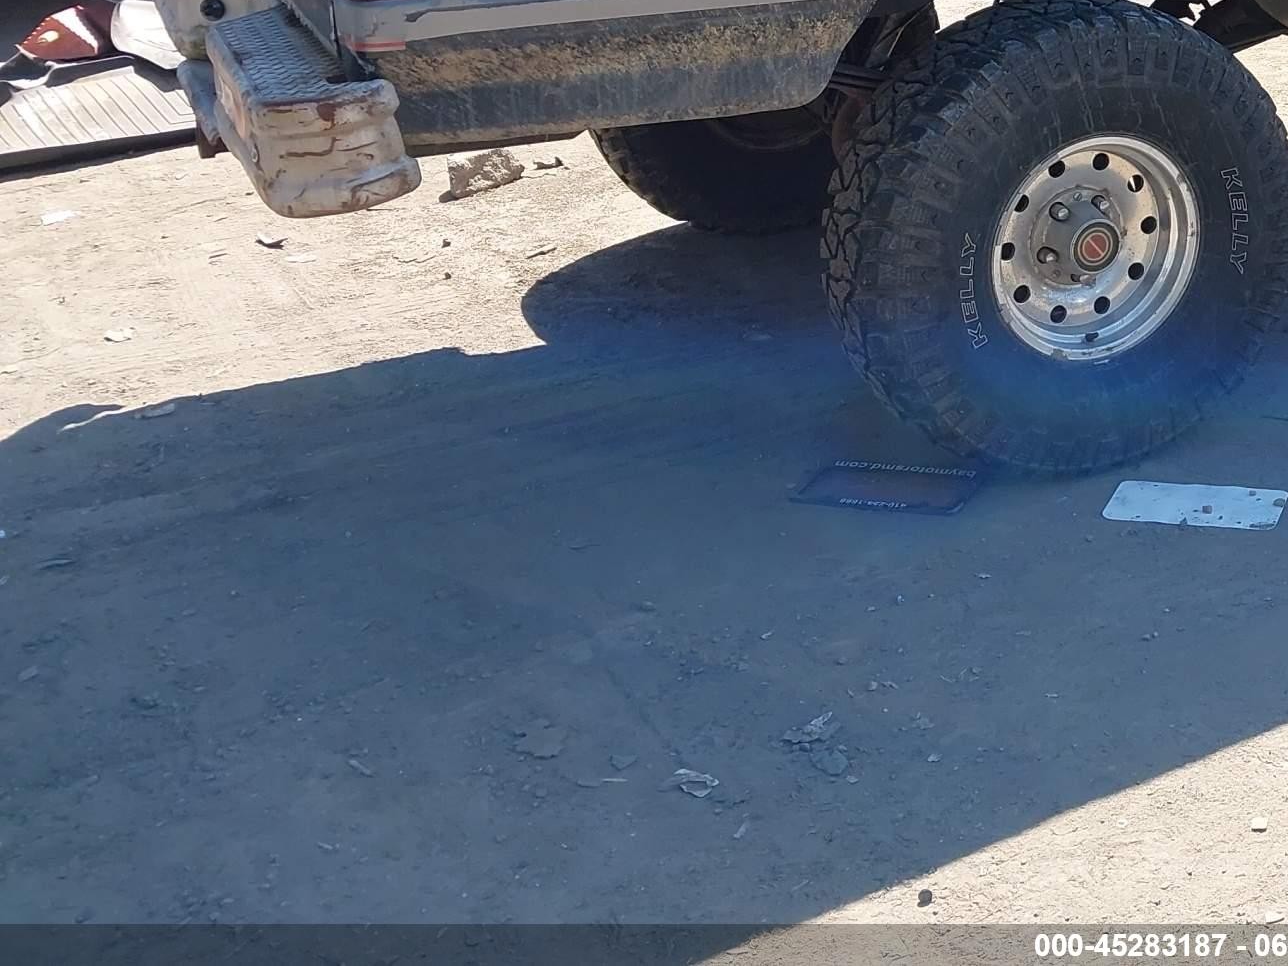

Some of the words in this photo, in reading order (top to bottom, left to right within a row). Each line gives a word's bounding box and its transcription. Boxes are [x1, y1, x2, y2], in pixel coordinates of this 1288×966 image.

[1221, 167, 1249, 275] KELLY
[960, 233, 988, 349] KELLY
[834, 459, 977, 479] baymotorsmd.com
